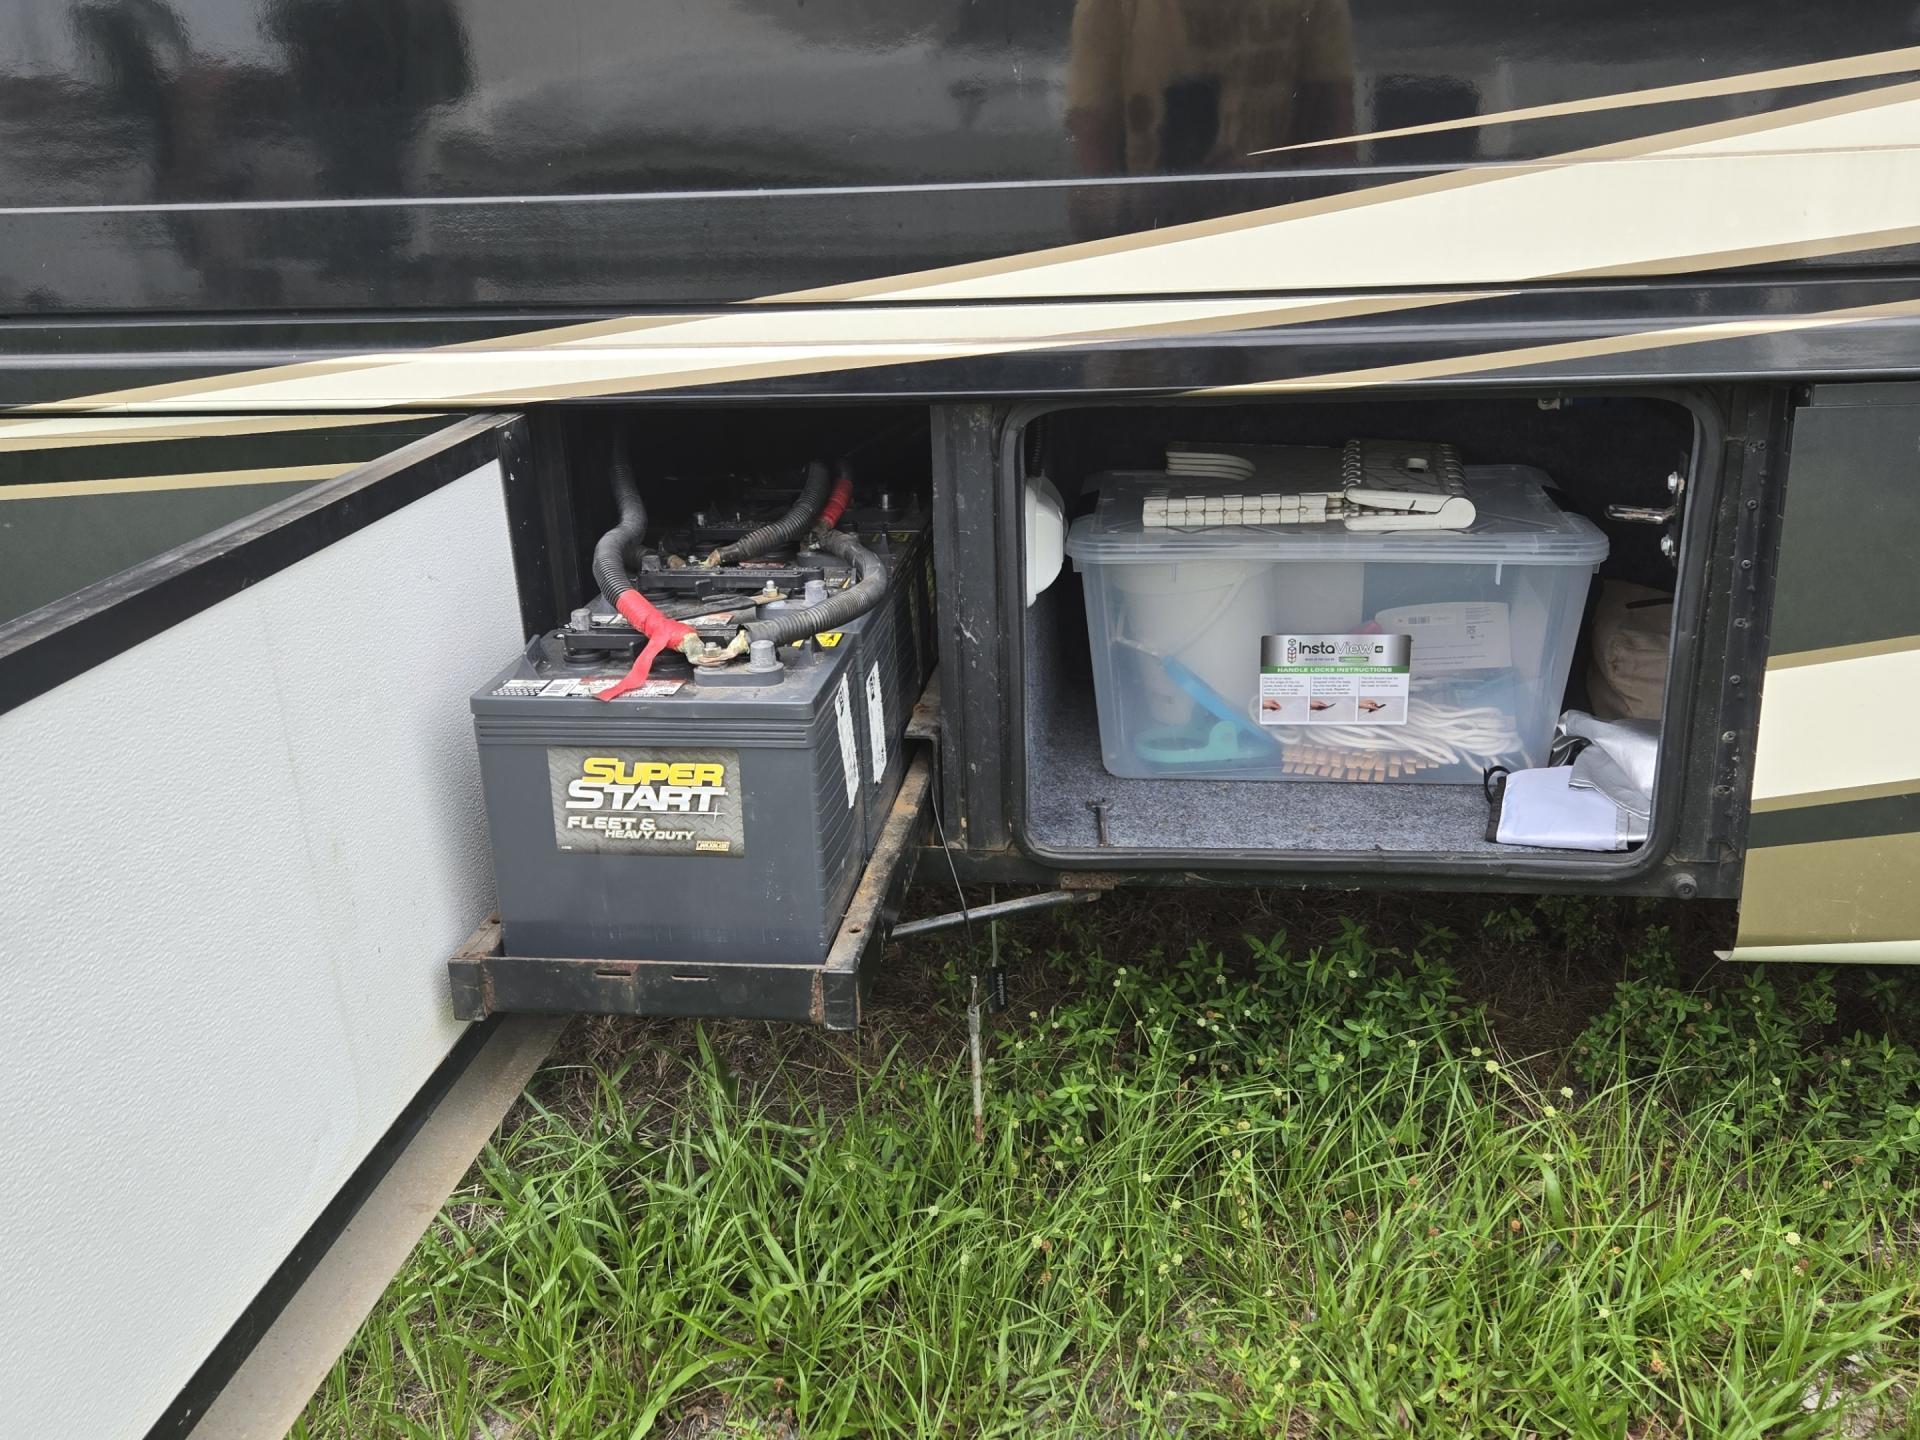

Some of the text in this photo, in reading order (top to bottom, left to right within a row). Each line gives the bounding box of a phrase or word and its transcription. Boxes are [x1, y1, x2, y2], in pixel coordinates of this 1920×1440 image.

[1299, 641, 1373, 655] InstaView
[582, 757, 725, 787] SUPER
[565, 780, 726, 812] START
[567, 816, 656, 831] FLEET &
[605, 830, 695, 841] HEAVY DUTY
